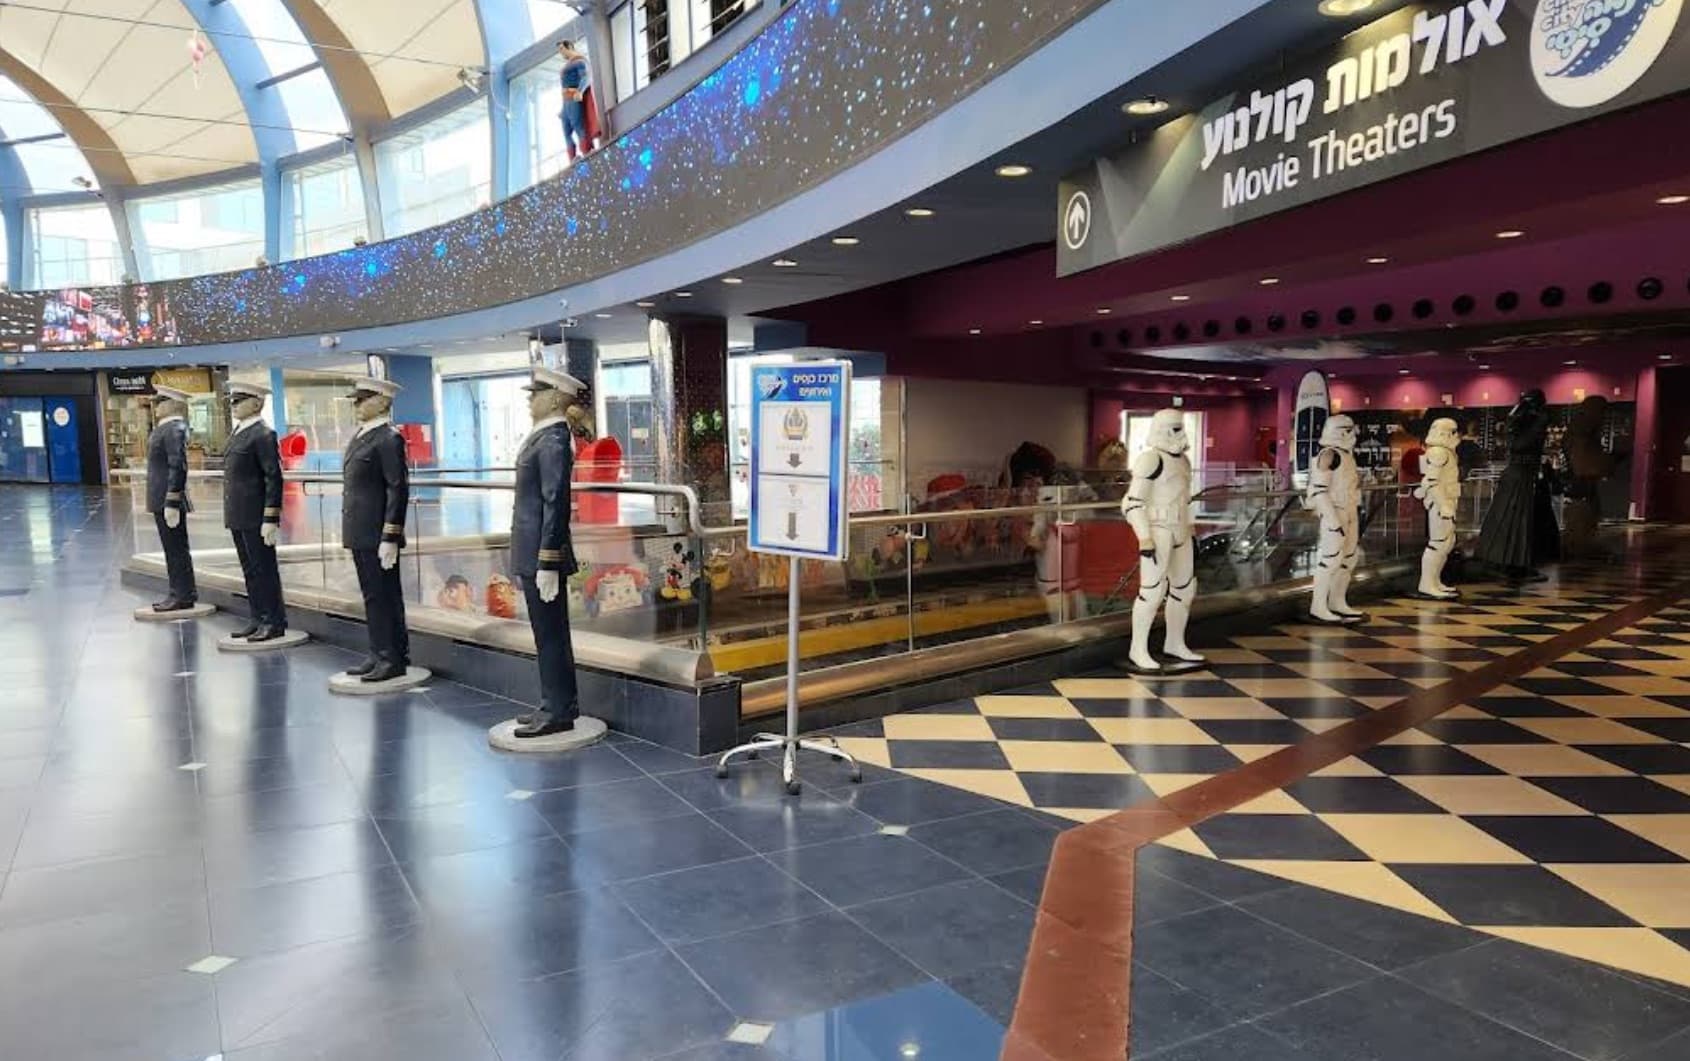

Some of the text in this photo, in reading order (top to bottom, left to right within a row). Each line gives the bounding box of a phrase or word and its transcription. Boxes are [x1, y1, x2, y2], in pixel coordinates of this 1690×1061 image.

[1201, 0, 1507, 171] אולמות קולנוע
[1222, 99, 1456, 208] Movie Theaters
